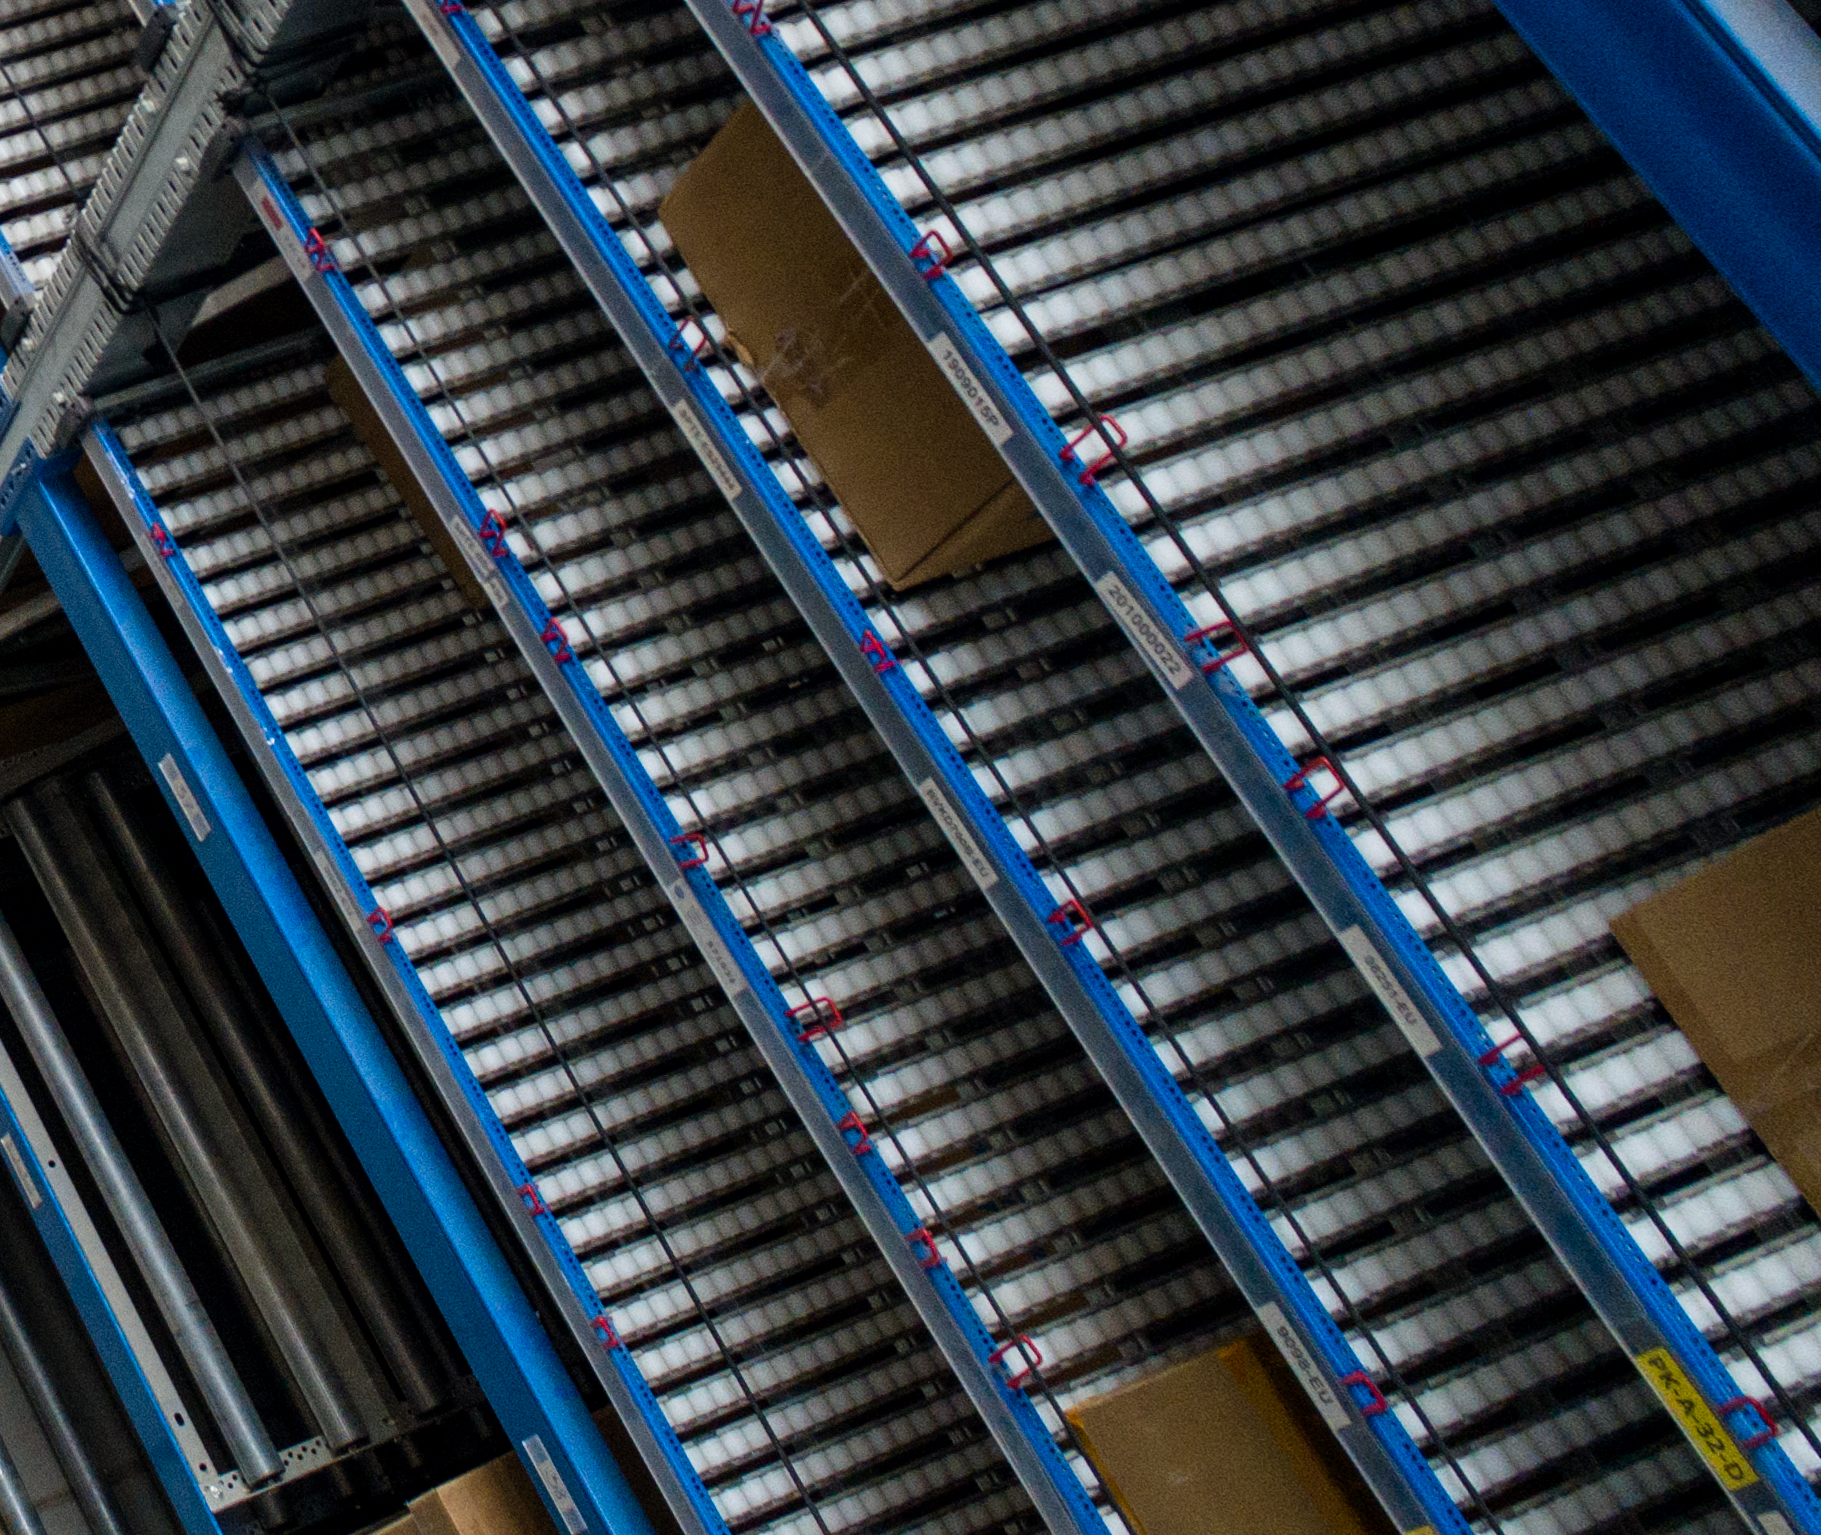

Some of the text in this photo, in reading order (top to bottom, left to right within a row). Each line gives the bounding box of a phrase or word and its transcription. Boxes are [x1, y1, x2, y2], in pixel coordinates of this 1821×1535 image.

[940, 347, 1001, 429] 1909015P
[1106, 583, 1183, 676] 201000022
[1274, 1323, 1335, 1408] 9098-EU
[1646, 1352, 1747, 1483] PK-A-32-D
